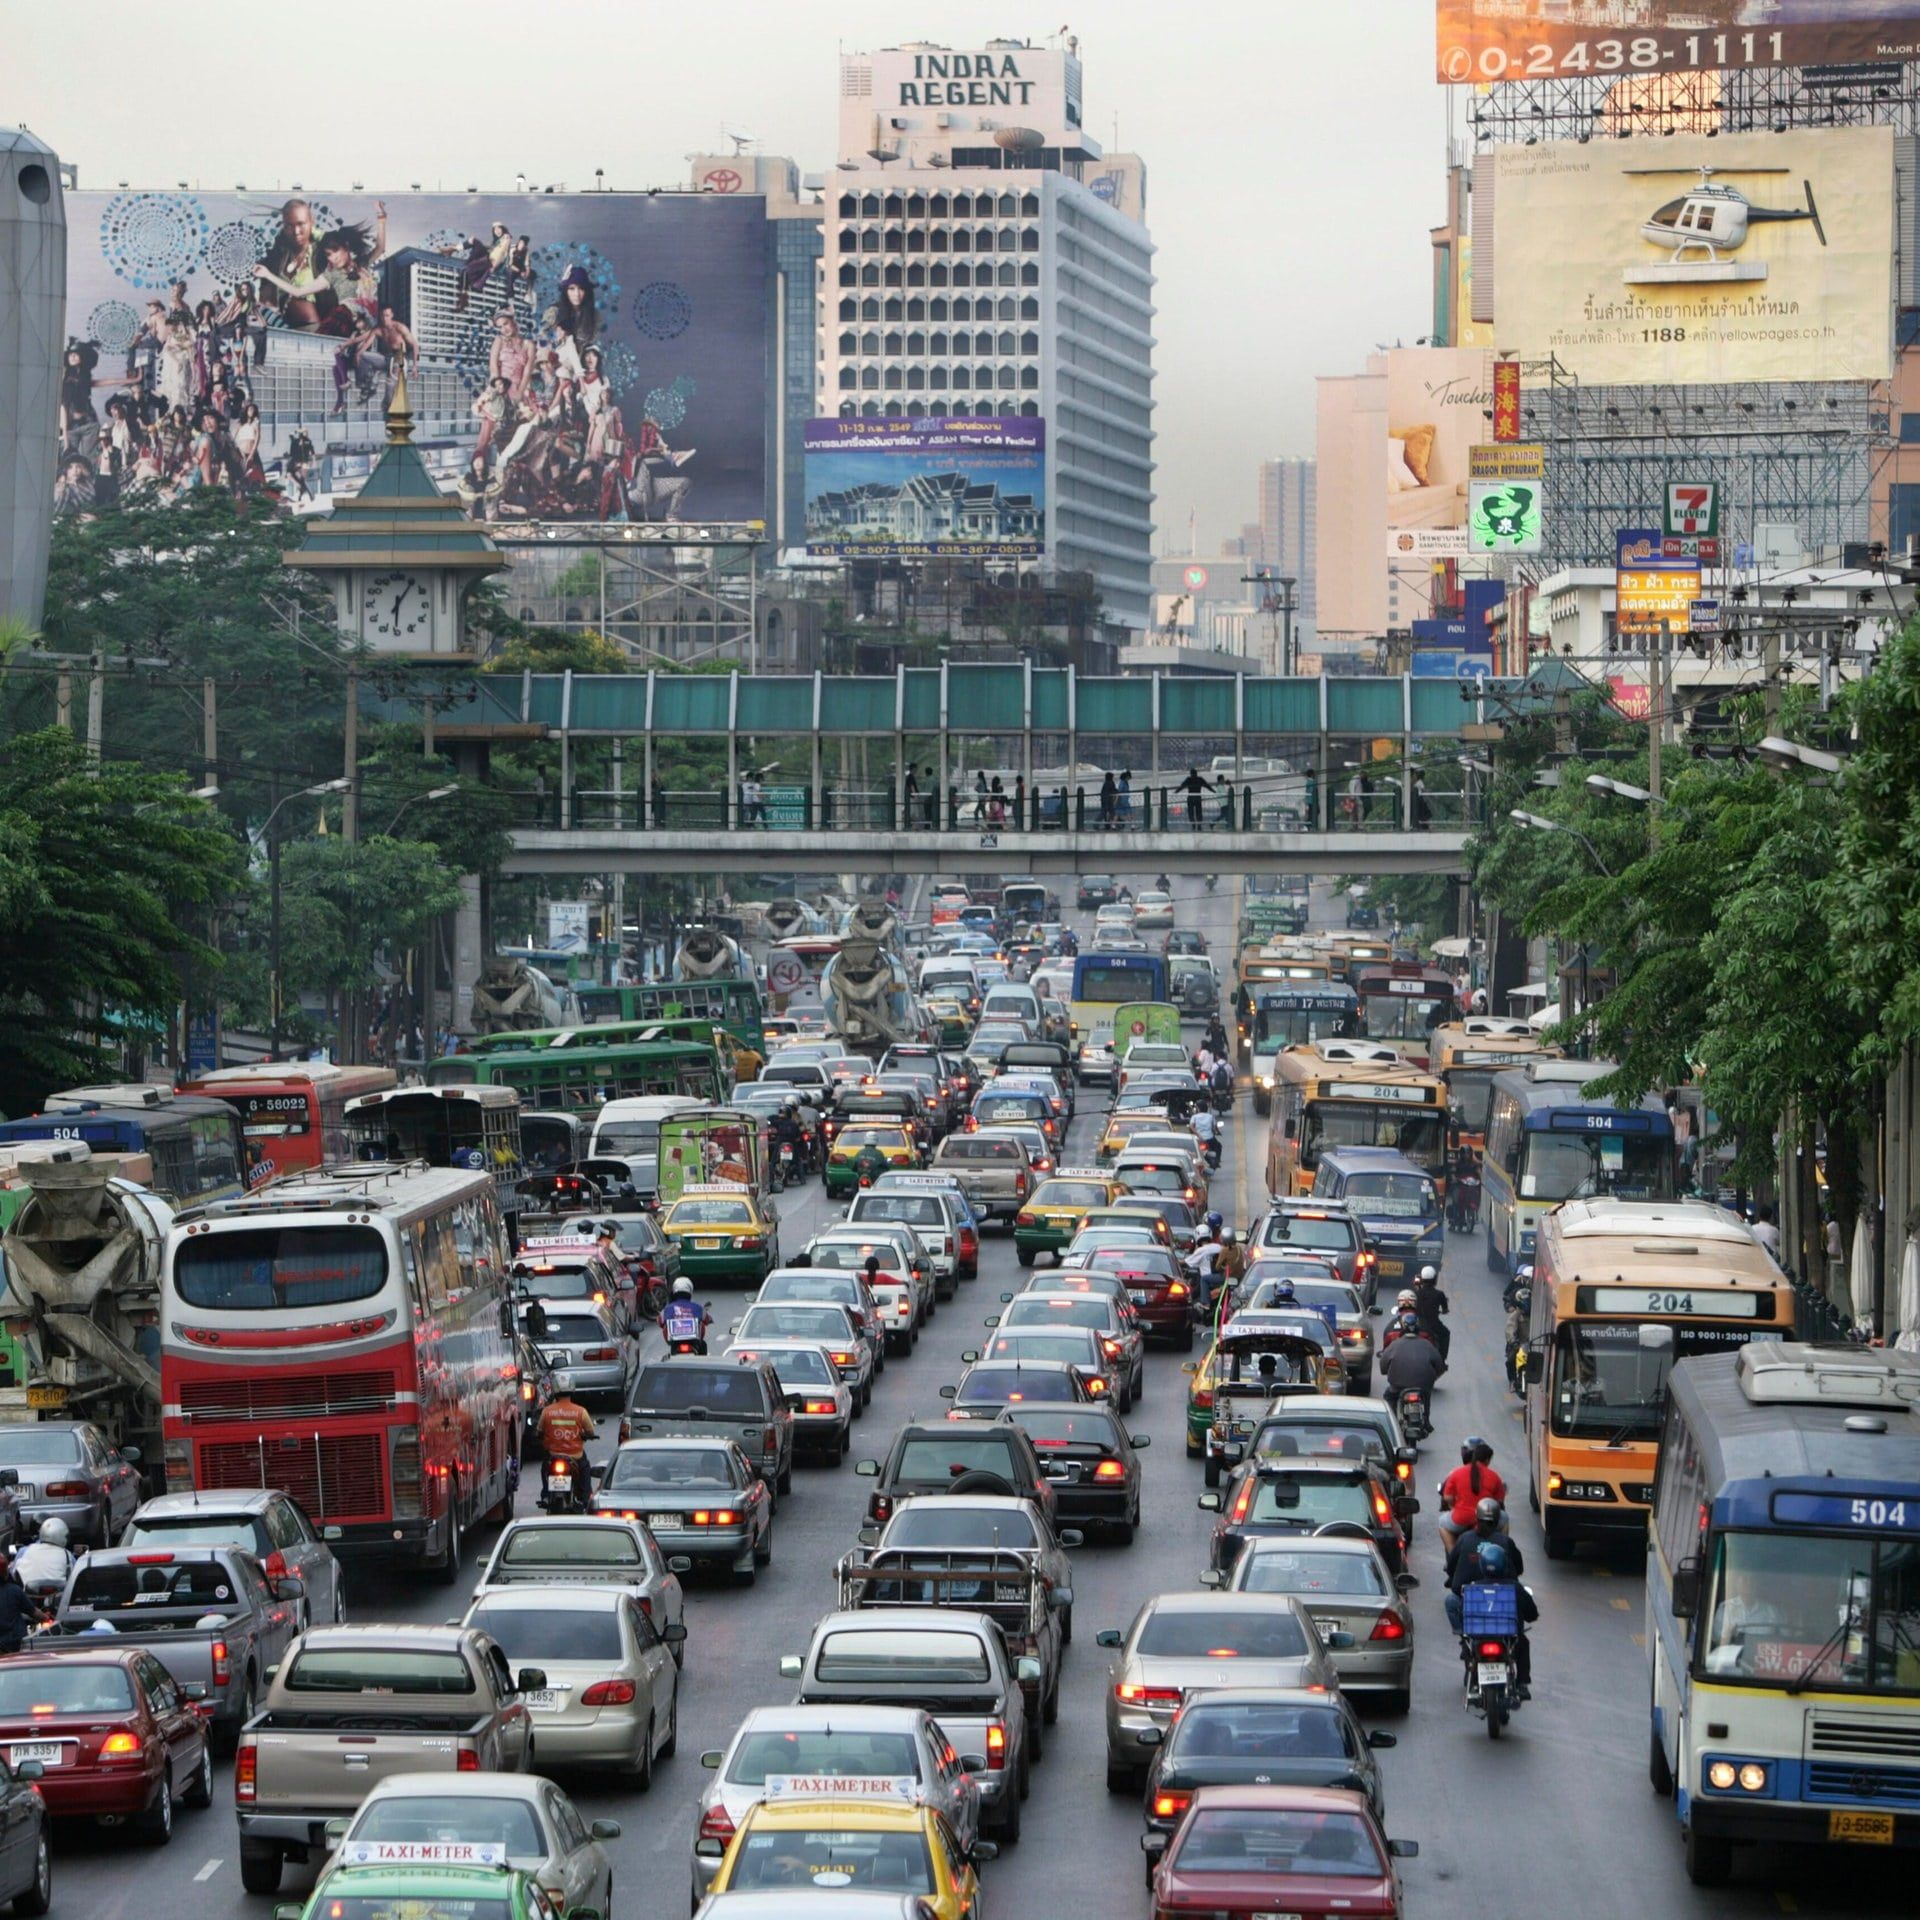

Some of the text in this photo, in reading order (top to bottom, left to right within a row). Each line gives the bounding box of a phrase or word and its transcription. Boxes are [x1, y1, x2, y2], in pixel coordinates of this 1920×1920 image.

[1478, 31, 1783, 76] 0-2438-1111
[914, 54, 1021, 79] INDRA
[899, 81, 1036, 106] REGENT
[1583, 294, 1800, 321] ขึ้นลำนี้ถ้าอยากเห็นร้านให้หมด
[1641, 327, 1686, 343] 1188
[1472, 464, 1539, 475] DRAGON RESTAURANT
[1681, 542, 1697, 555] 24
[1110, 958, 1127, 967] 504
[1301, 998, 1314, 1009] 17
[1331, 1019, 1344, 1032] 17
[1374, 1086, 1400, 1098] 204
[1587, 1116, 1613, 1129] 504
[53, 1127, 80, 1140] 504
[1648, 1292, 1694, 1313] 204
[1680, 1330, 1695, 1339] ISO
[1697, 1331, 1749, 1341] 9001:2000
[1851, 1499, 1906, 1526] 504
[530, 1690, 554, 1701] 3652
[33, 1744, 58, 1756] 3357
[790, 1778, 893, 1793] TAXI-METER
[377, 1844, 474, 1859] TAXI-METER
